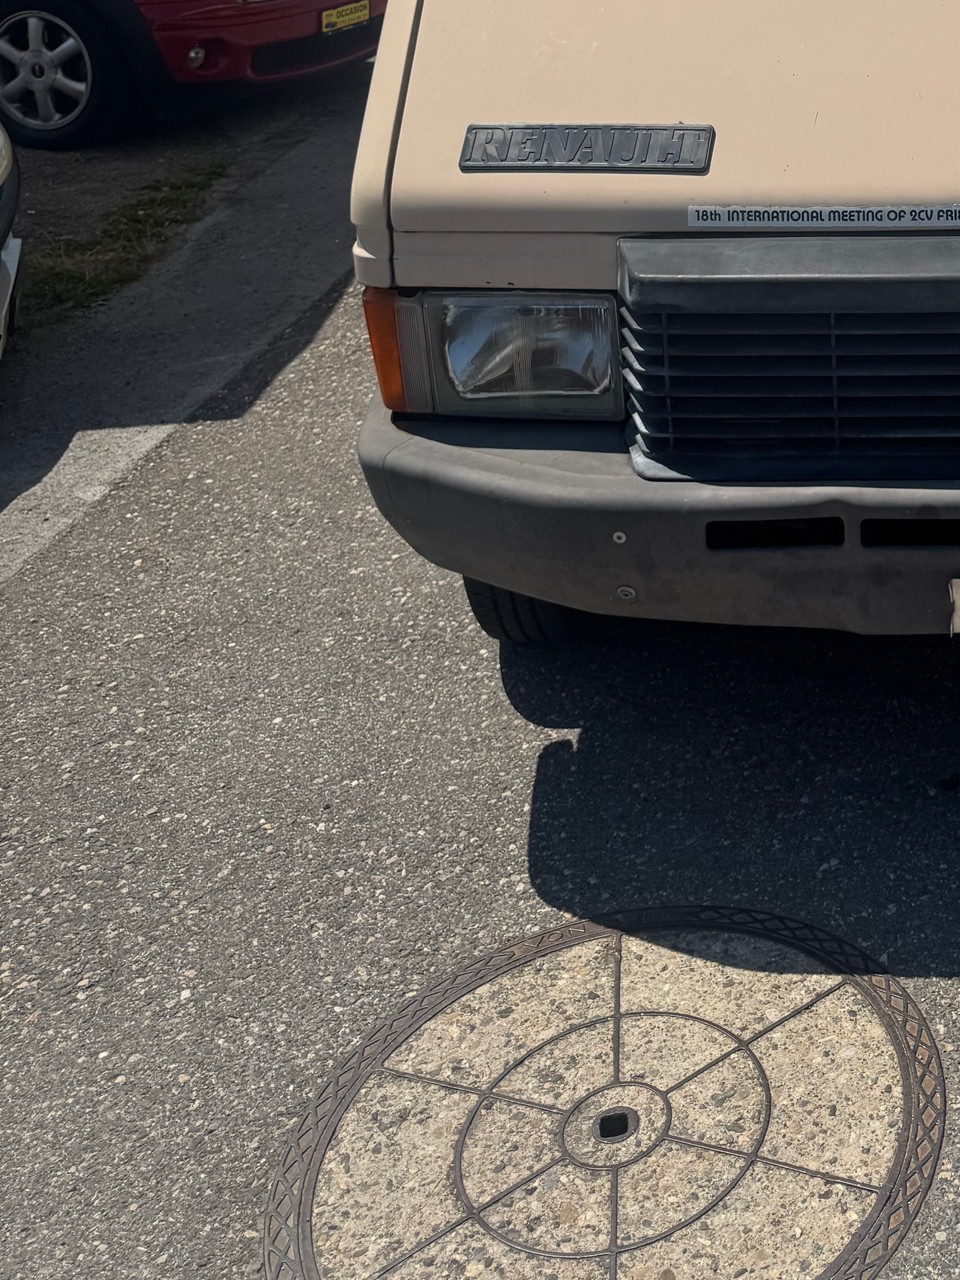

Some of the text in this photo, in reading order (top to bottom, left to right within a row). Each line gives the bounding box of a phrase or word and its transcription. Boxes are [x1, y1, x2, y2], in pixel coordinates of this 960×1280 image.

[336, 1, 368, 19] OCCASION
[464, 127, 708, 167] RENAULT
[694, 209, 722, 222] 18th
[727, 209, 825, 222] INTERNATIONAL
[828, 209, 884, 222] MEETING
[886, 208, 907, 222] OF
[909, 208, 934, 222] 2CV
[522, 923, 587, 949] VON
